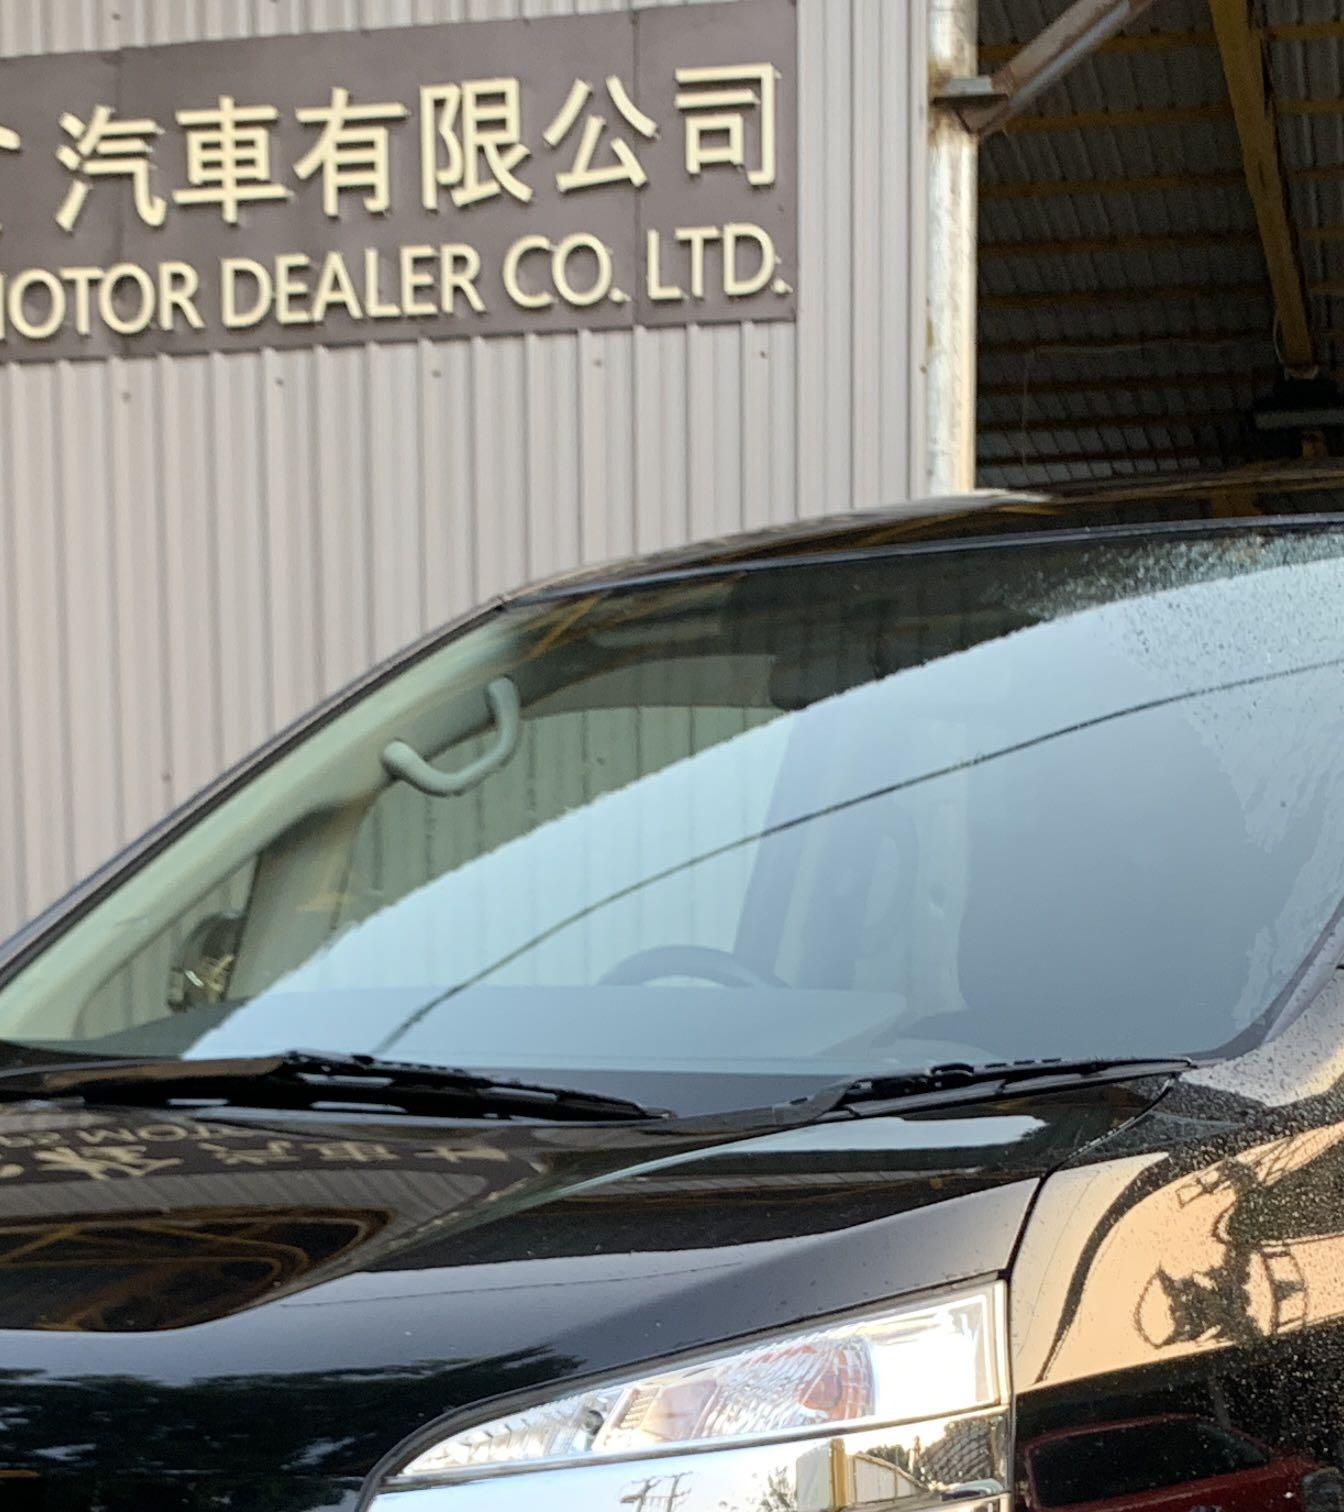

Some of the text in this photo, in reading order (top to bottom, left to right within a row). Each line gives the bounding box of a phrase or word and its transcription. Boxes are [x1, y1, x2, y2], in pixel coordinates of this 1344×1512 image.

[220, 243, 487, 329] DEALER
[503, 232, 631, 309] CO.
[646, 223, 794, 301] LTD.
